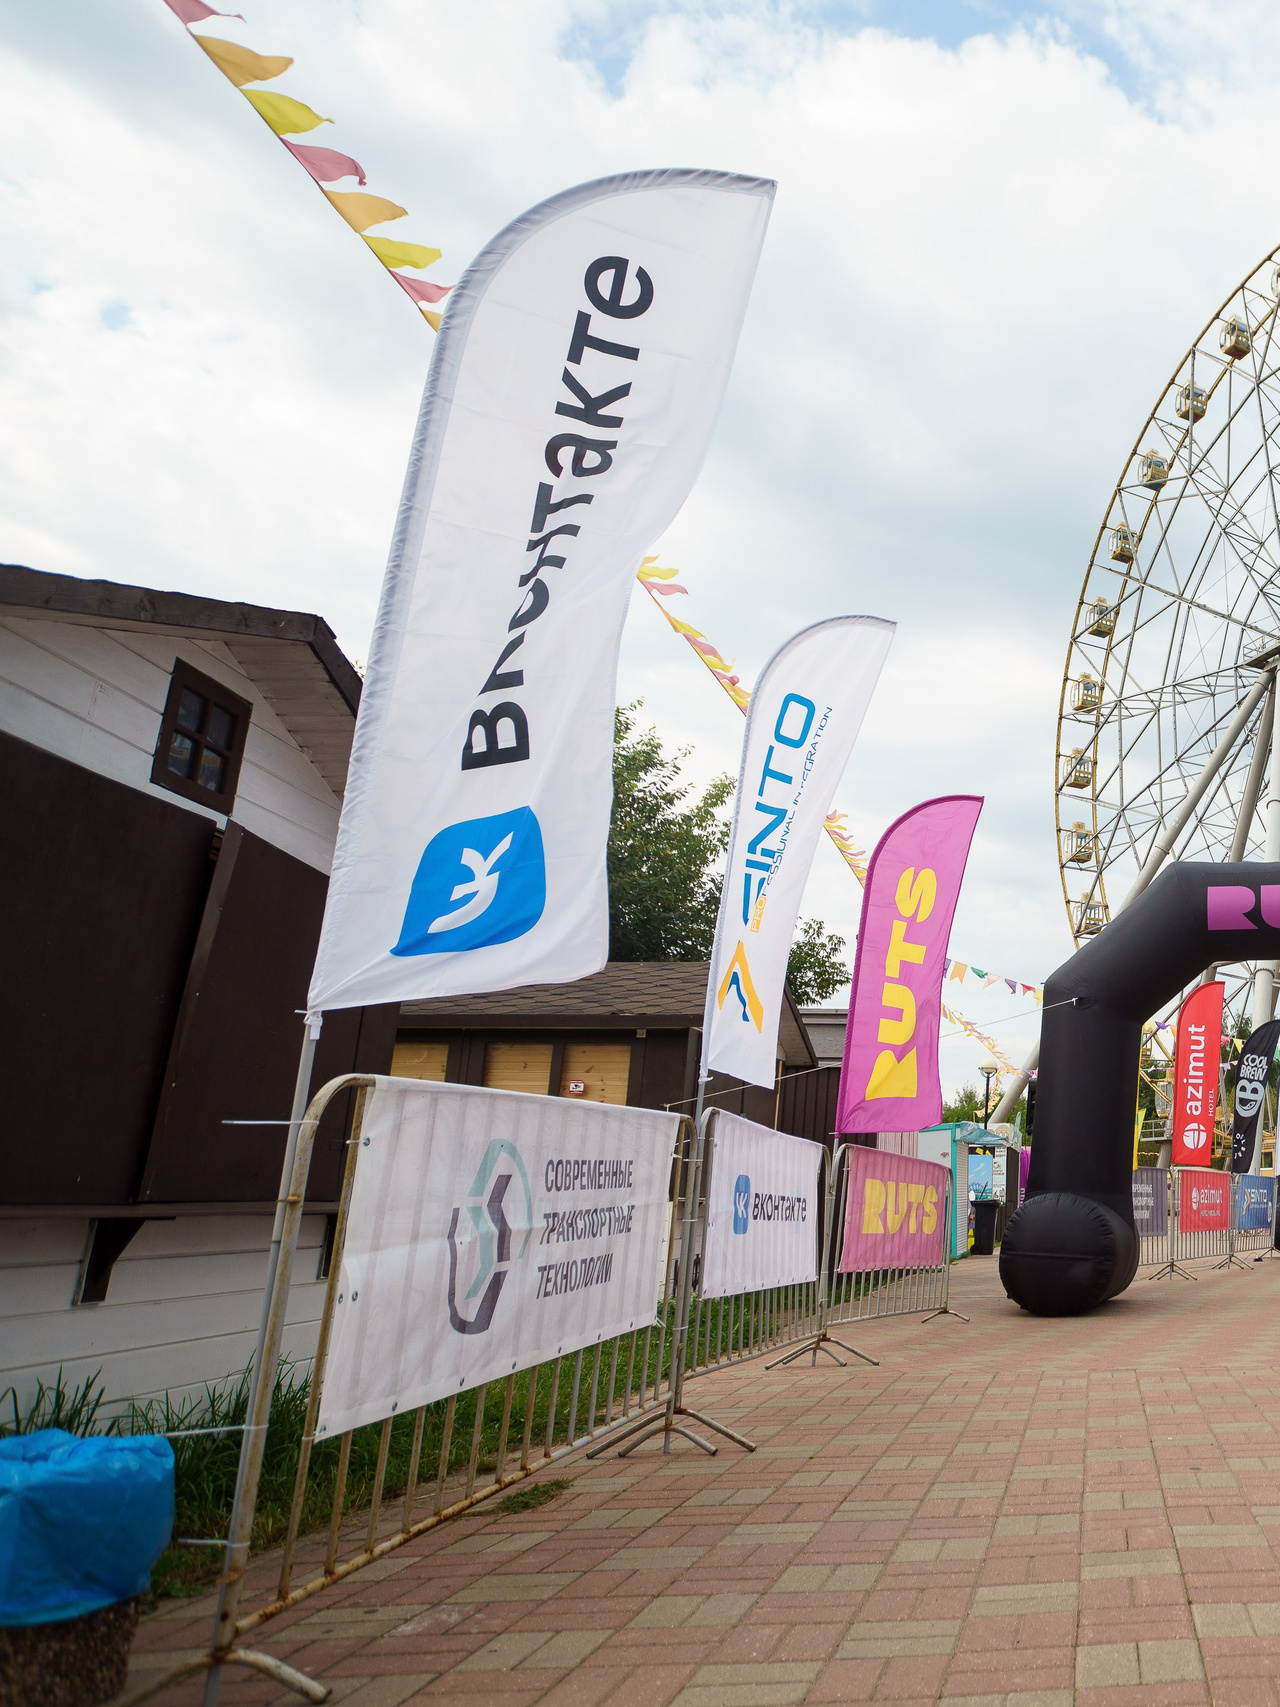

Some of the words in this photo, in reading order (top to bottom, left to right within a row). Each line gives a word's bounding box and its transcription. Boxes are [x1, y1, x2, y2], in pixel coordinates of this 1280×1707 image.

[742, 693, 816, 926] SINTO
[865, 867, 937, 1100] RUTS
[1183, 1024, 1206, 1116] azimut
[1240, 1065, 1267, 1081] BREW
[1243, 1053, 1268, 1069] COOL
[545, 1159, 633, 1192] СОВРЕМЕННЫЕ
[1201, 1184, 1223, 1204] azimut
[539, 1205, 635, 1245] ТРАНСПОРТНЫЕ
[862, 1179, 938, 1234] RUTS
[536, 1253, 613, 1299] ТЕХНОЛОГИИ
